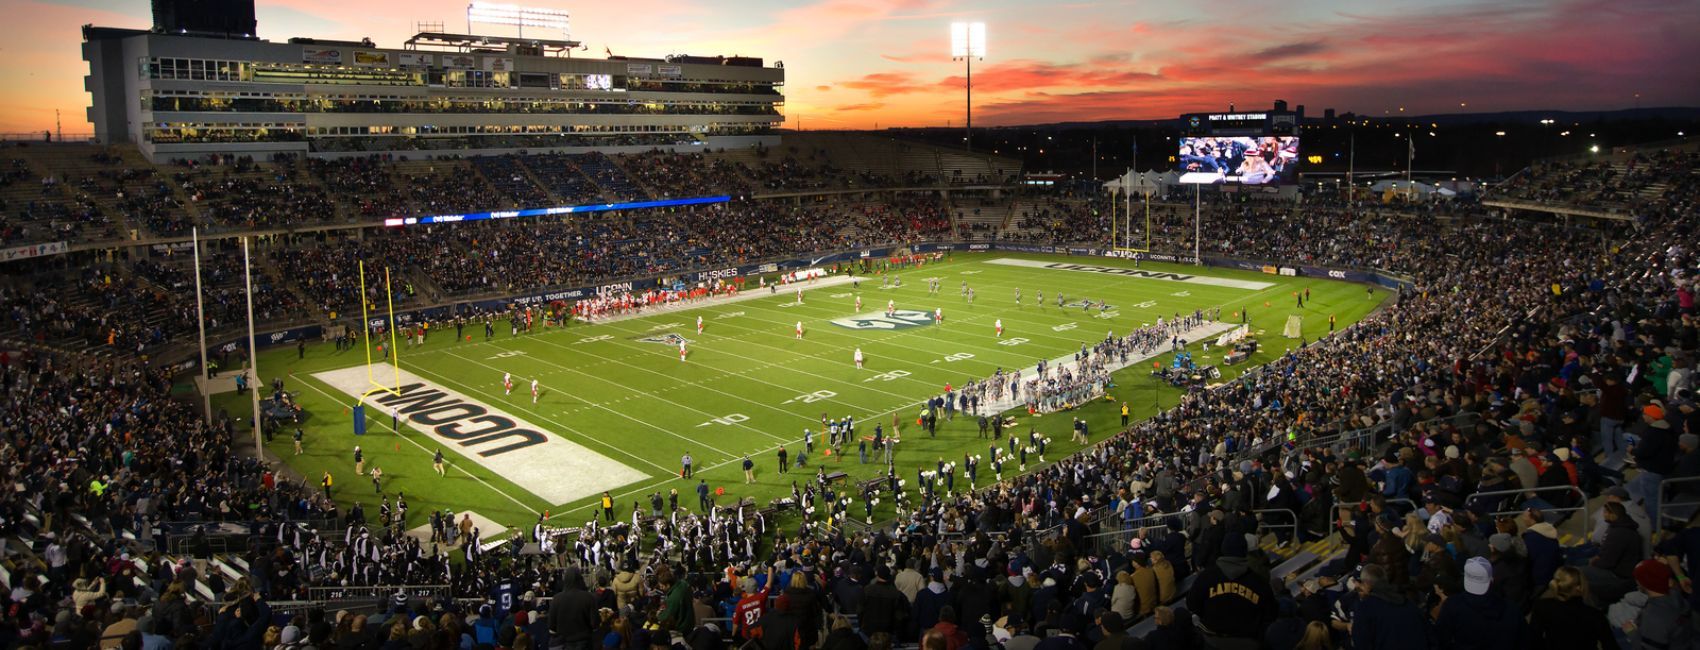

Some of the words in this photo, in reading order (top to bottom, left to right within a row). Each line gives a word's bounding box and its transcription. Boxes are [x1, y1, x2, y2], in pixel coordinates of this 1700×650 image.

[1045, 263, 1195, 281] UCONN
[873, 369, 912, 381] 30
[794, 389, 838, 404] 20
[361, 382, 549, 458] UCONN
[710, 413, 751, 426] 10
[501, 593, 512, 610] 9
[744, 607, 761, 625] 87
